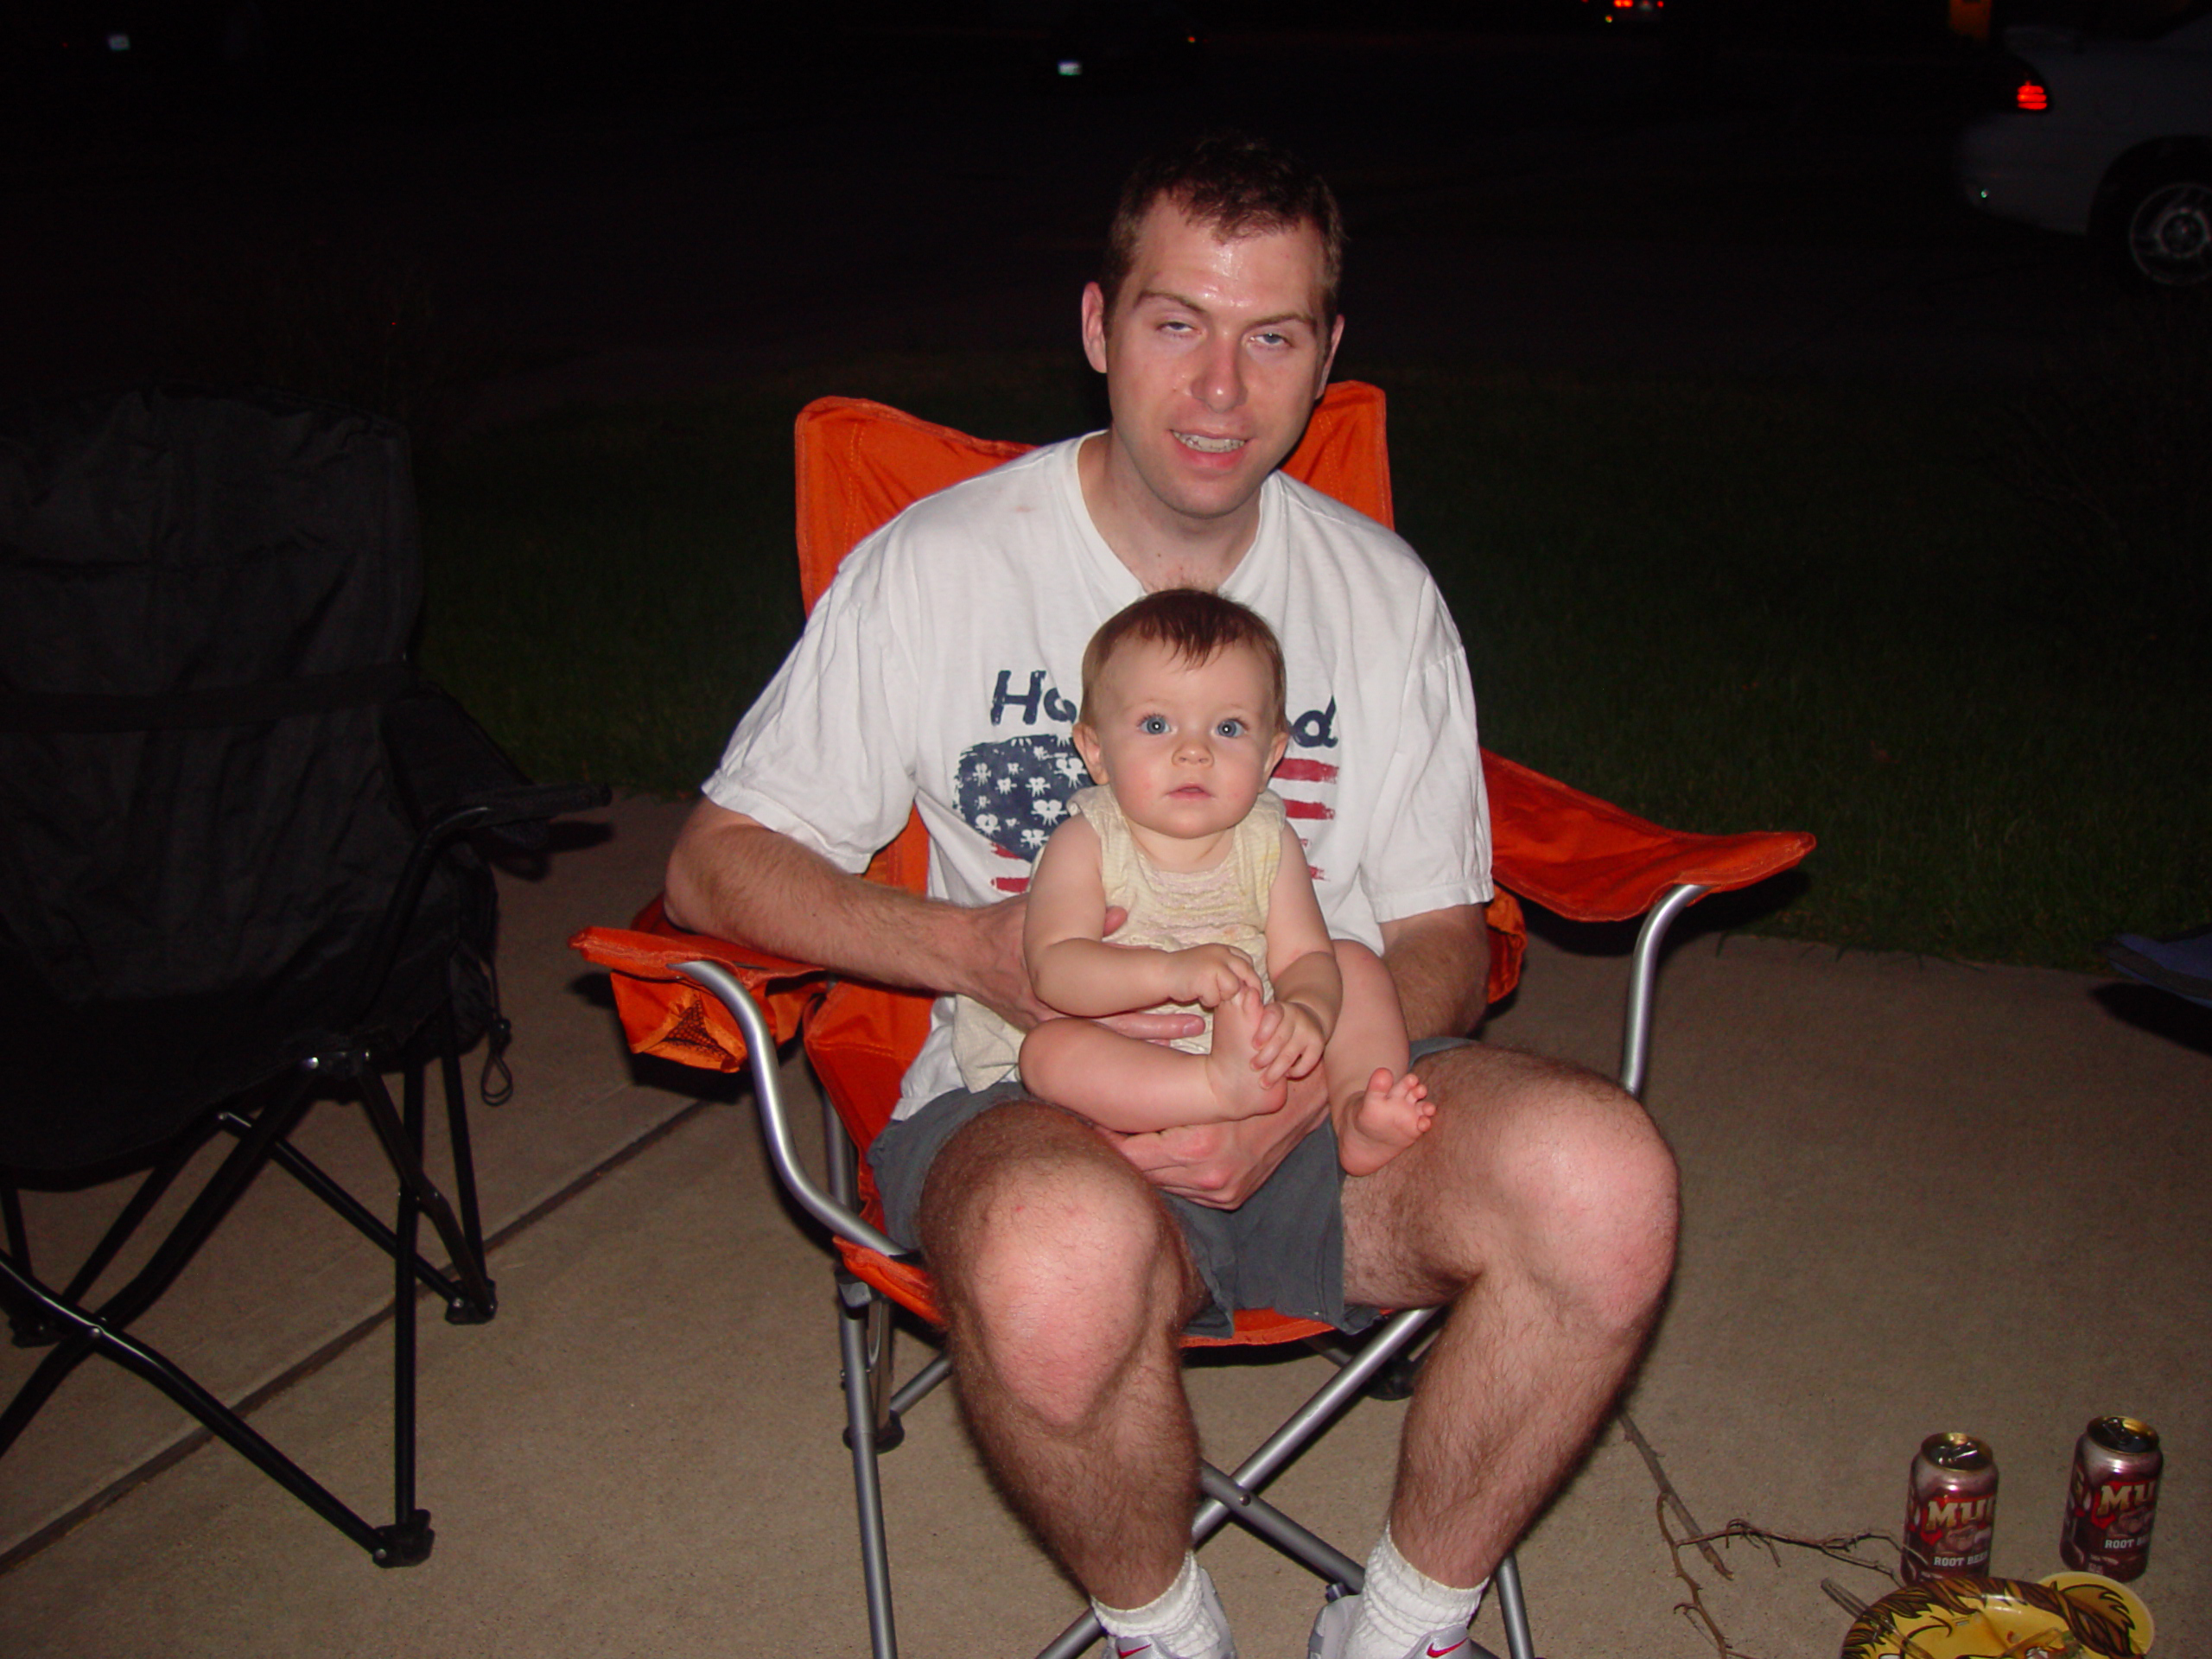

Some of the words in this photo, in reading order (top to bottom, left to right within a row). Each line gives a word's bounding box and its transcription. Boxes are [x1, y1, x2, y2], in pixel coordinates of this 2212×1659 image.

[2098, 1480, 2156, 1516] MU
[2103, 1538, 2135, 1549] ROOT
[1933, 1555, 1966, 1567] ROOT
